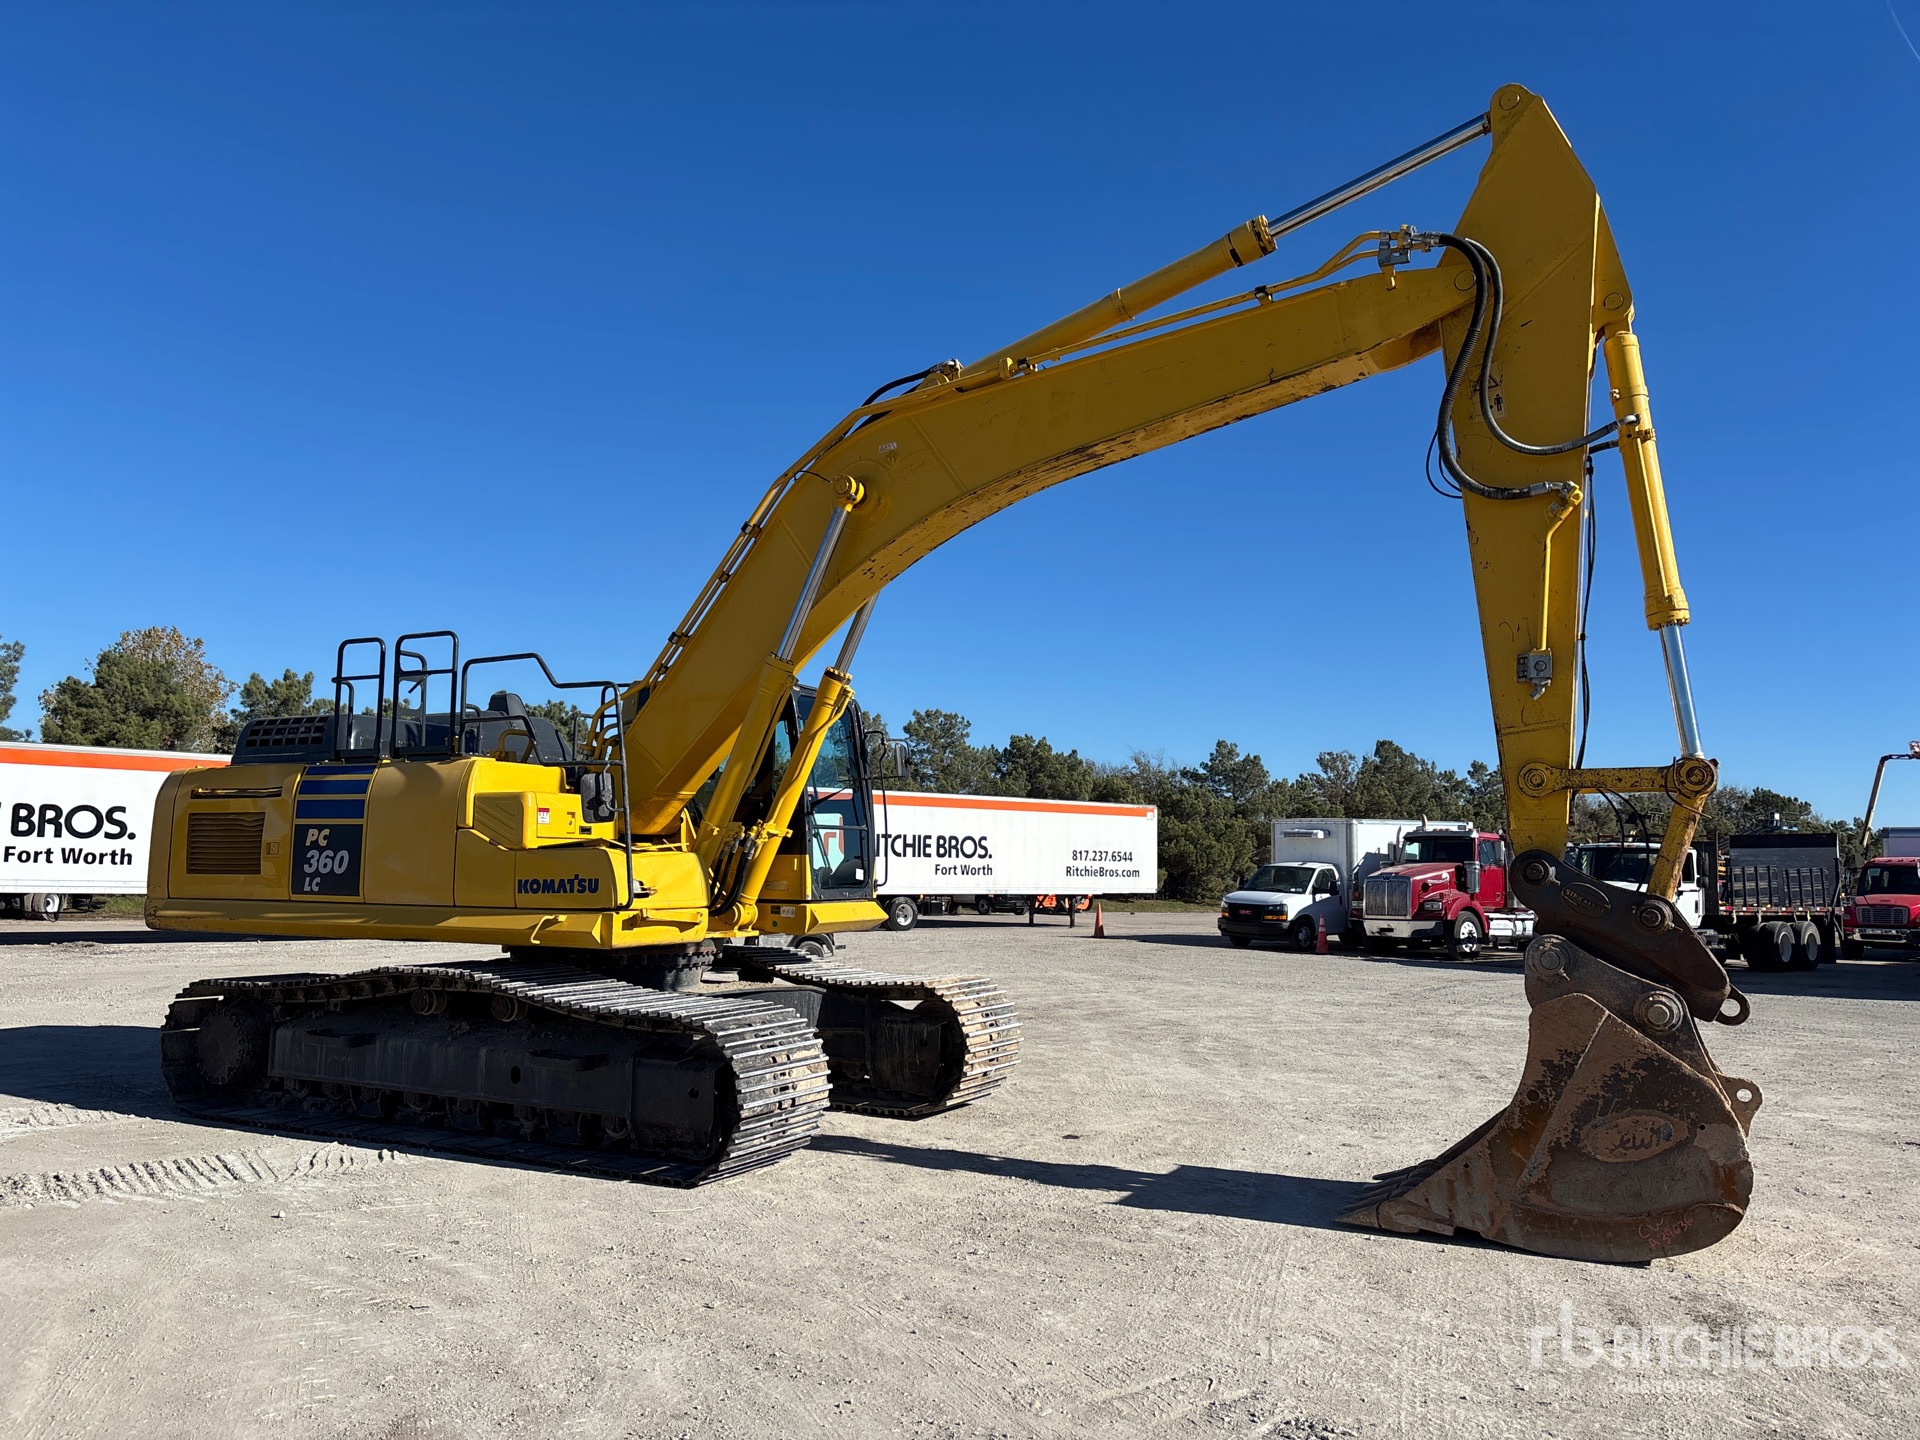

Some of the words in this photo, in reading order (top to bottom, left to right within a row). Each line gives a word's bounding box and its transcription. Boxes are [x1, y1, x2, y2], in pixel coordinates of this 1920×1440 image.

[11, 803, 136, 840] BROS.
[305, 828, 330, 846] PC
[3, 846, 54, 864] Fort
[61, 847, 133, 865] Worth
[875, 834, 932, 858] ITCHIE
[936, 835, 993, 859] BROS.
[303, 849, 350, 874] 360
[1072, 850, 1133, 862] 817.237.6544
[934, 864, 958, 876] Fort
[960, 865, 993, 876] Worth
[1066, 866, 1140, 878] RitchieBros.com
[303, 877, 321, 891] LC
[517, 874, 600, 894] KOMATSU
